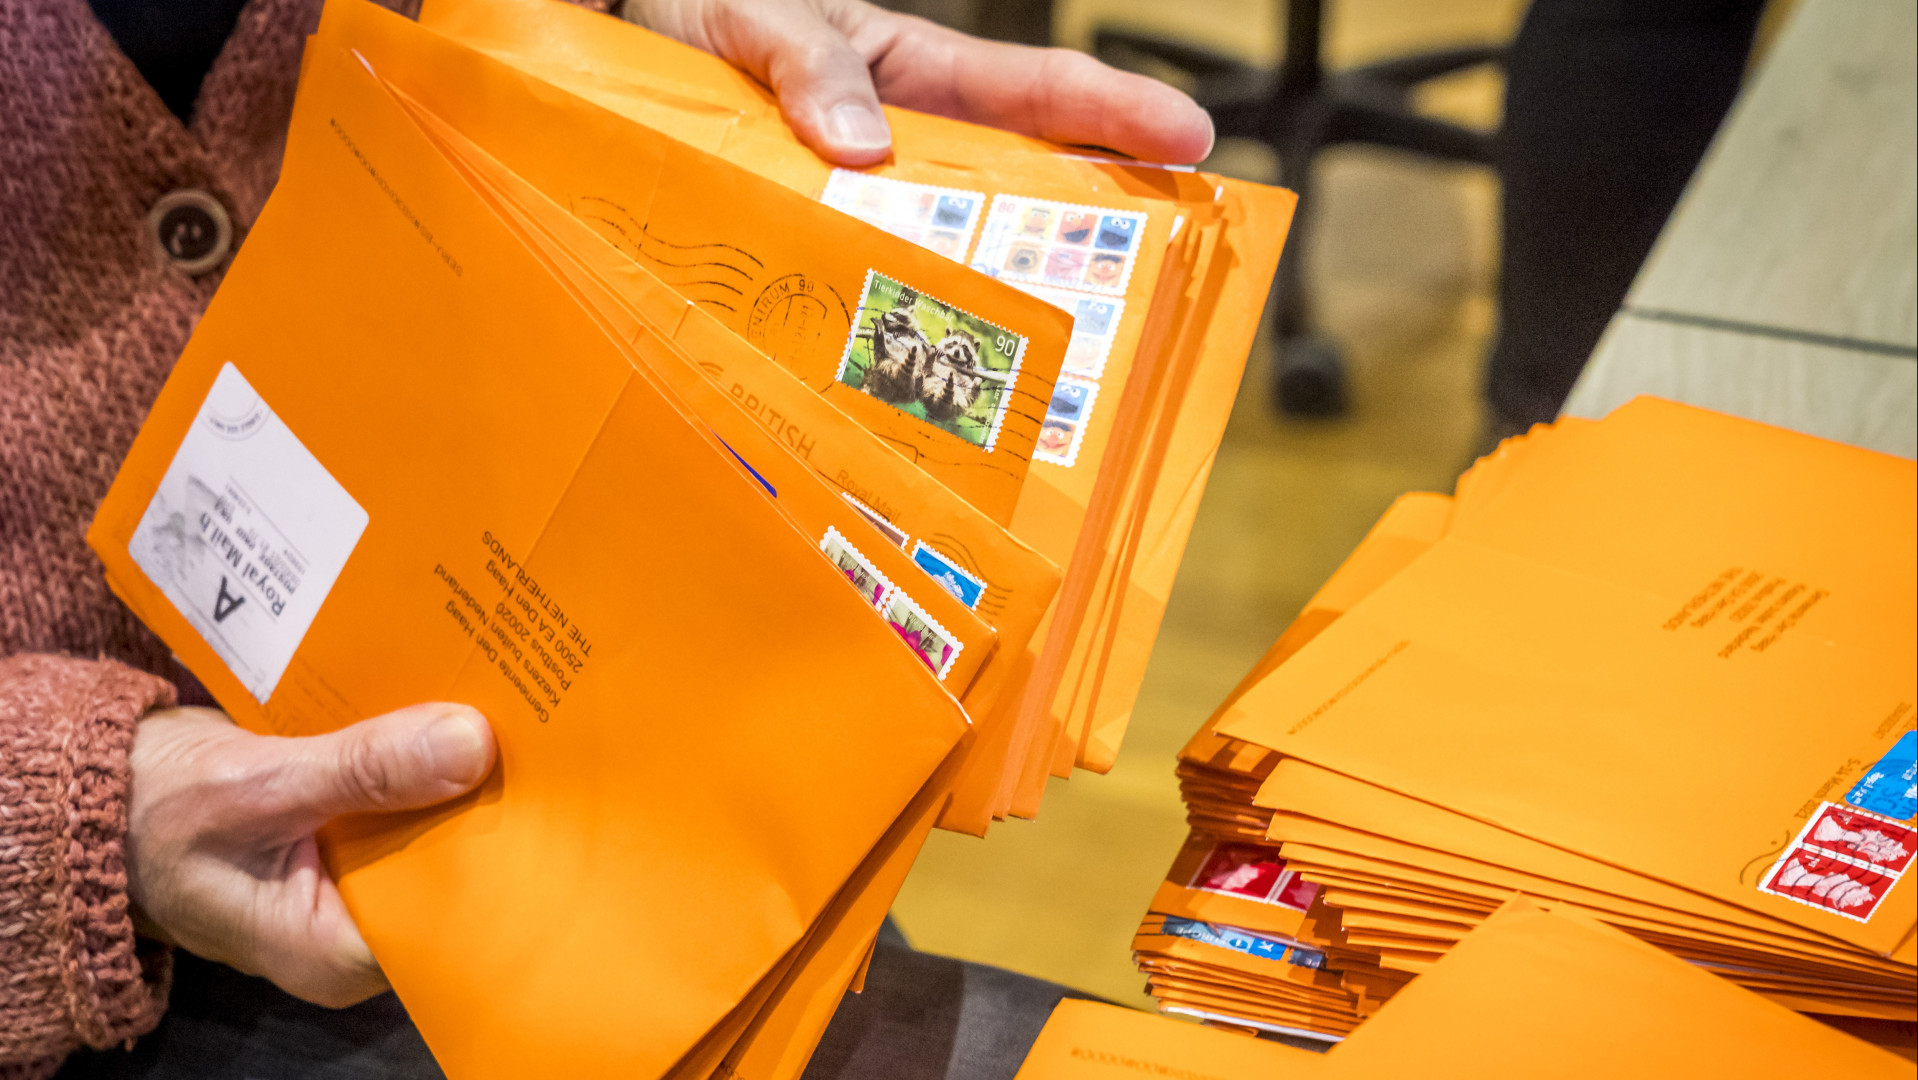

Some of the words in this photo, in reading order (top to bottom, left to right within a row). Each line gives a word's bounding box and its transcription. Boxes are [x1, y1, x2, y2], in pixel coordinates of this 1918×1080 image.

[998, 201, 1015, 213] 80
[798, 278, 814, 293] 90
[873, 279, 912, 305] Tierkinder
[994, 335, 1015, 357] 90
[836, 469, 872, 501] Royal
[873, 496, 900, 523] Mail
[242, 562, 287, 615] Royal
[434, 563, 489, 624] Nederland
[481, 531, 567, 626] NETHERLANDS
[484, 560, 513, 596] Haag
[213, 575, 246, 624] A
[515, 594, 538, 622] Den
[444, 600, 474, 635] Haag
[495, 602, 528, 640] 20020
[537, 619, 555, 641] EA
[475, 635, 497, 661] Den
[488, 622, 522, 660] buiten
[554, 640, 582, 672] 2500
[568, 625, 591, 656] THE
[530, 639, 571, 689] Postbus
[497, 660, 549, 722] Gemeente
[522, 659, 560, 706] Kiezers
[1815, 776, 1840, 797] March
[1794, 800, 1818, 818] 2021
